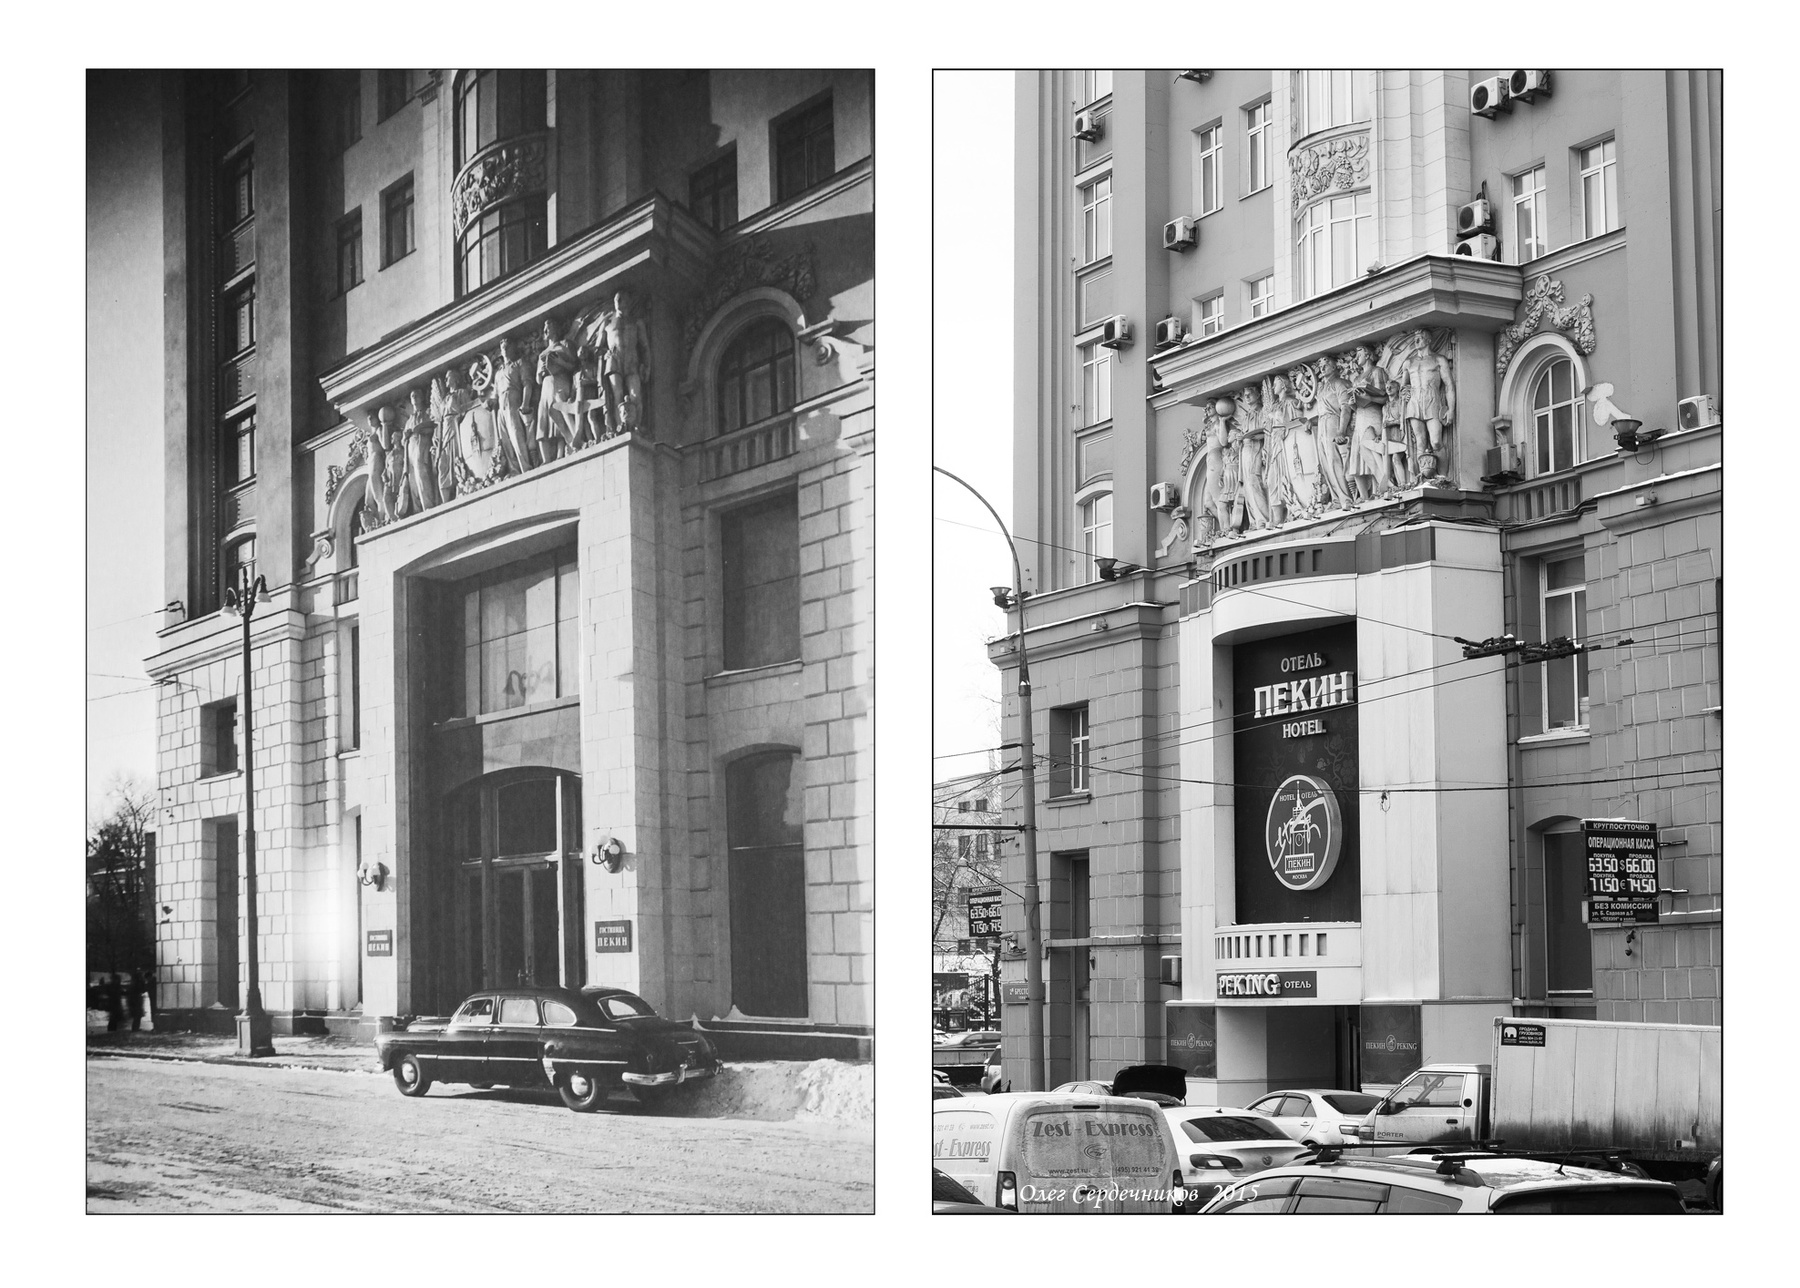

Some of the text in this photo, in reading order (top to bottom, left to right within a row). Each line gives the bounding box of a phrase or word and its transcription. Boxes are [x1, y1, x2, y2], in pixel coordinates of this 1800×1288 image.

[1280, 652, 1323, 673] ОТЕЛЬ
[1254, 671, 1354, 718] ПЕКИН
[1282, 719, 1326, 738] HOTEL
[1280, 794, 1296, 802] HOTEL
[1593, 822, 1650, 830] КРУГЛОСУТОЧНО
[1588, 836, 1654, 850] ОПЕРАЦИОННАЯ КАССА
[1288, 858, 1311, 868] ПЕКИН
[1588, 858, 1618, 872] 63.50
[1626, 858, 1656, 873] 66.00
[1590, 878, 1619, 892] 71.50
[1627, 878, 1656, 893] 74.50
[989, 907, 1001, 917] 66.0
[989, 922, 1002, 932] 74.5
[597, 937, 627, 946] ПЕКИН
[1219, 974, 1280, 995] PEKING
[1032, 1120, 1072, 1137] Zest
[1085, 1120, 1154, 1137] Express
[949, 1139, 992, 1157] Express
